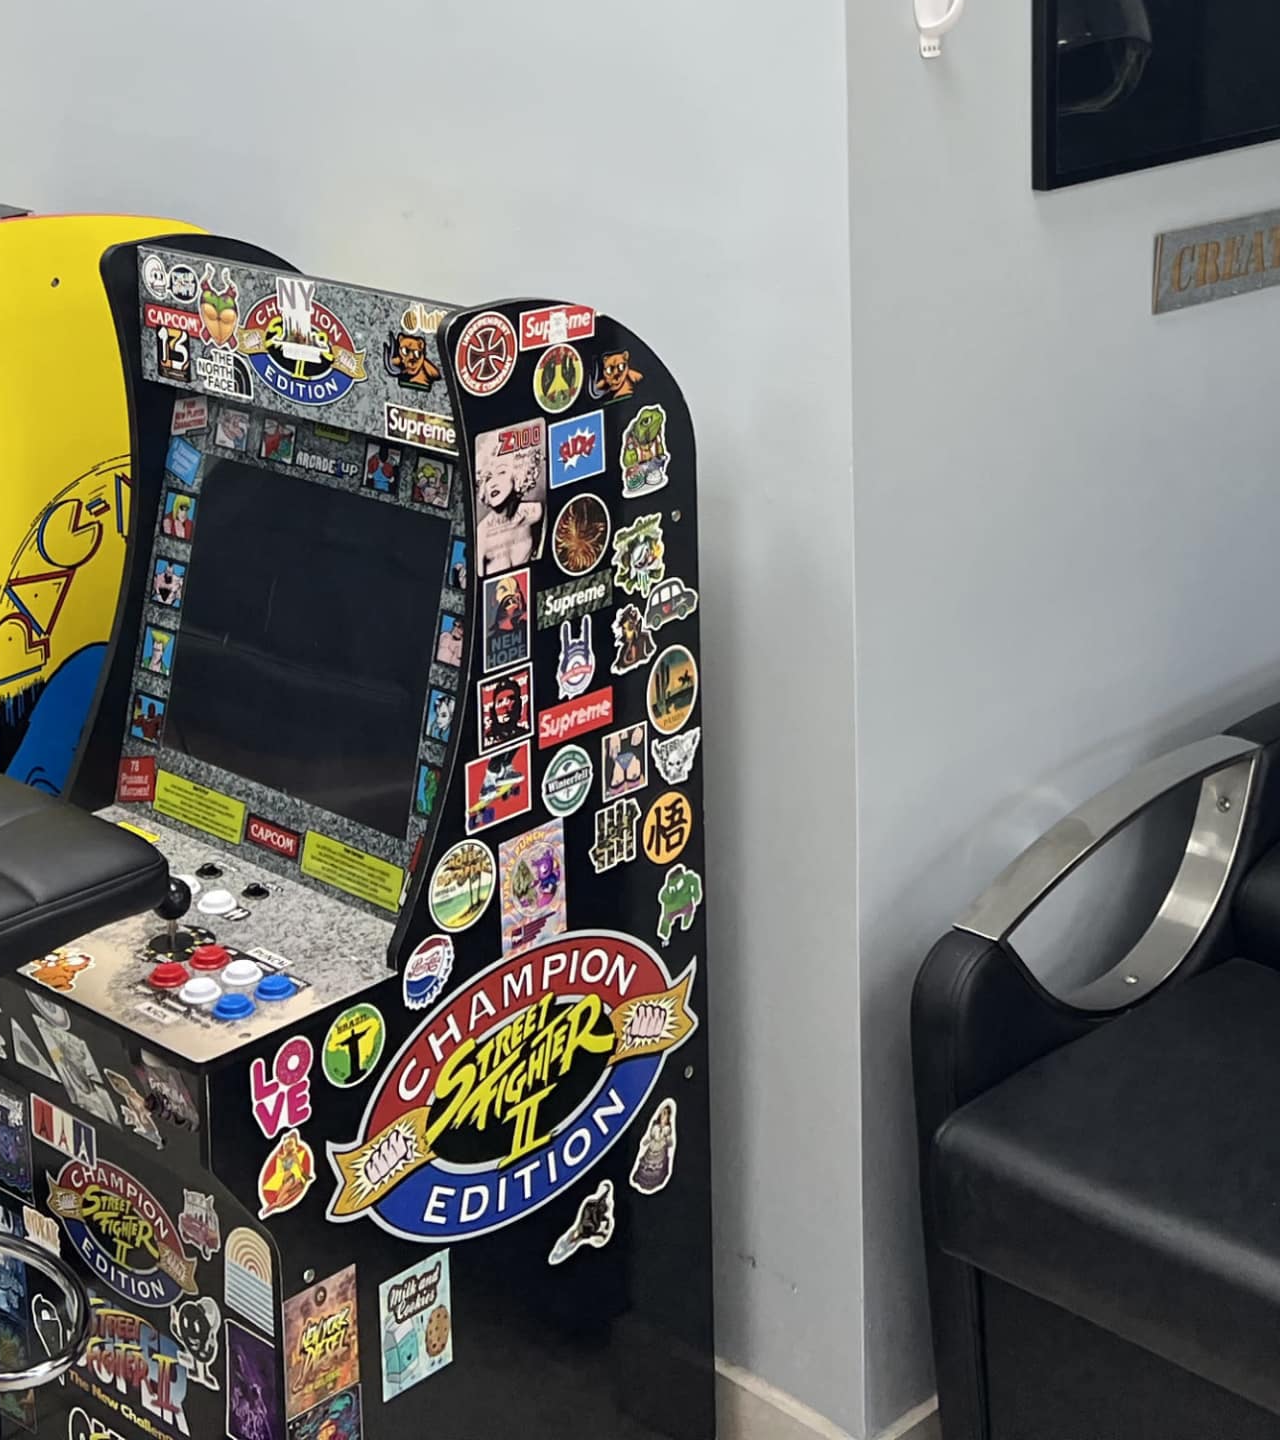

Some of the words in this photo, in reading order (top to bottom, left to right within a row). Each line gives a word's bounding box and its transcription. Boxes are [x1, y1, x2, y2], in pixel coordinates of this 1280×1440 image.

[278, 280, 315, 310] NY
[148, 309, 198, 334] CAPCOM
[524, 312, 591, 339] Supme
[198, 361, 233, 379] NORTH
[213, 351, 233, 366] THE
[208, 376, 234, 393] FACE
[264, 365, 339, 400] EDITION
[388, 408, 457, 444] Supreme
[545, 584, 606, 616] Supreme
[487, 643, 526, 668] HOPE
[491, 630, 522, 652] NEW
[540, 698, 612, 738] Supreme
[548, 768, 589, 793] Winterfell
[250, 823, 295, 852] CAPCOM
[645, 798, 689, 859] 悟
[398, 948, 638, 1101] CHAMPION
[425, 992, 555, 1145] STREET
[452, 993, 615, 1131] FIGHTER
[497, 1083, 558, 1168] II
[423, 1089, 625, 1224] EDITION
[71, 1166, 170, 1240] CHAMPION
[81, 1185, 132, 1216] STREET
[93, 1211, 160, 1259] FIGHTER
[82, 1238, 165, 1299] EDITION
[390, 1278, 417, 1309] Milk
[418, 1265, 440, 1290] and
[397, 1289, 436, 1320] Cookies
[69, 1370, 91, 1393] The
[91, 1384, 120, 1412] New
